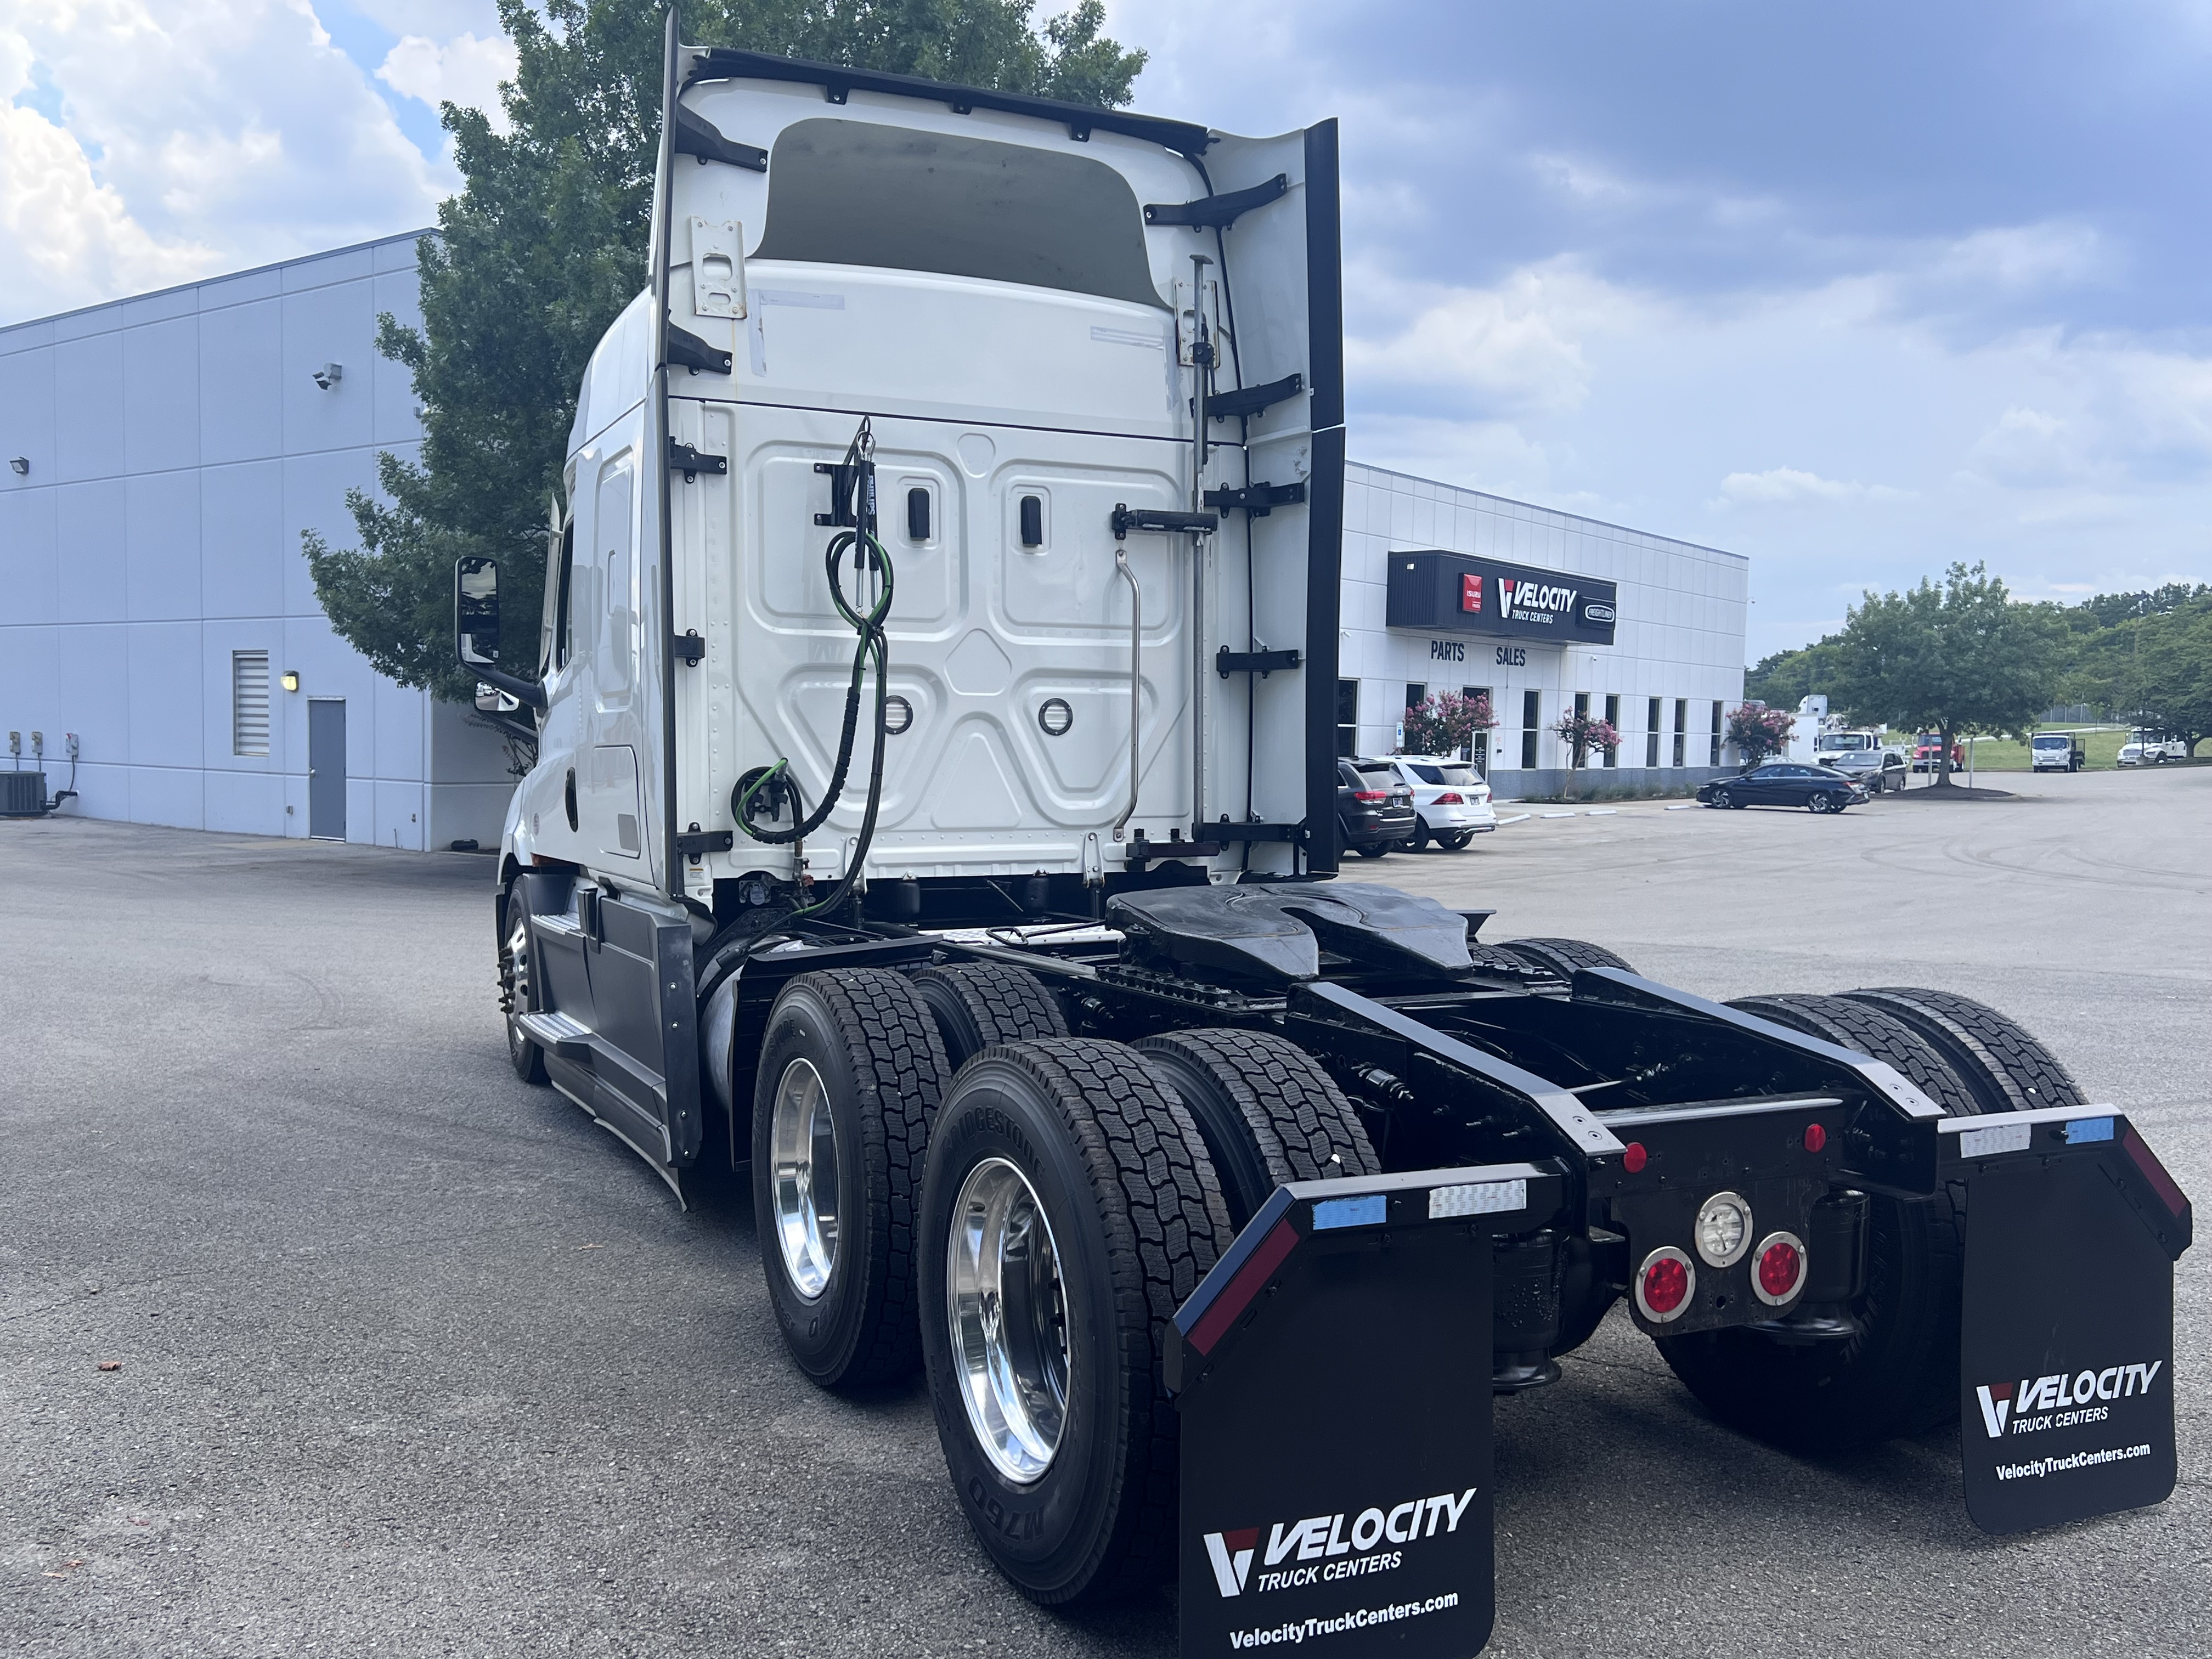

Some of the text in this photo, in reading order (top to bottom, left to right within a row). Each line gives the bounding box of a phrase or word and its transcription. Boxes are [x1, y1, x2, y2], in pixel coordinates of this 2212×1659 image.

[1514, 581, 1577, 612] VELOCITY
[1512, 609, 1554, 624] TRUCK CENTERS
[1431, 640, 1465, 662] PARTS
[1496, 647, 1526, 667] SALES
[2016, 1361, 2162, 1413] VELOCITY
[2012, 1406, 2109, 1434] TRUCK CENTERS
[1996, 1443, 2151, 1481] VelocityTruckCenters.com
[1265, 1488, 1477, 1566] VELOCITY
[1258, 1551, 1402, 1592] TRUCK CENTERS
[1230, 1592, 1458, 1649] VelocityTruckCenters.com
